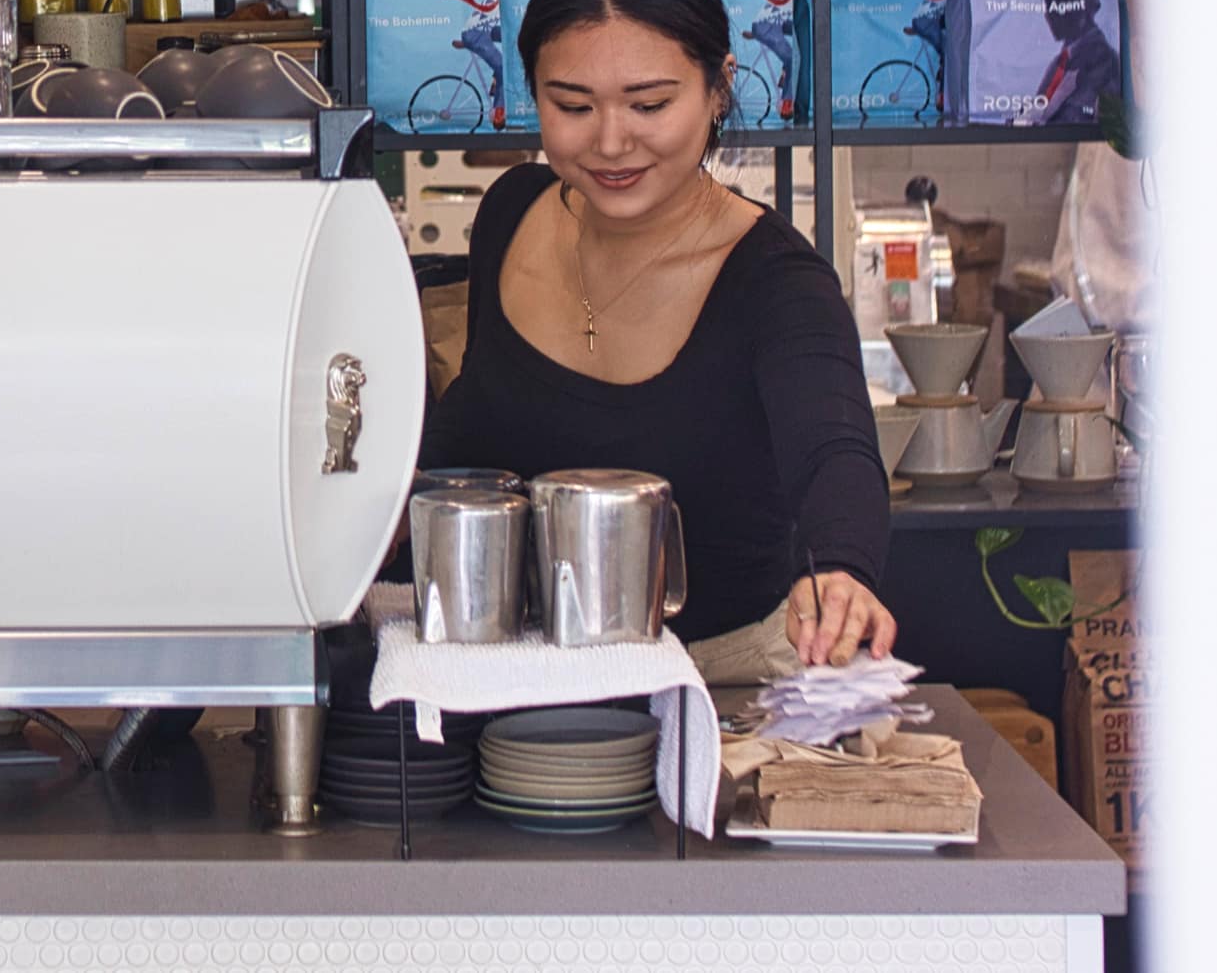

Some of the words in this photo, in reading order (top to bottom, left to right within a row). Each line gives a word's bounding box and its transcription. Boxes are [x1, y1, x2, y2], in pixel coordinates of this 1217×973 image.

[986, 0, 1008, 12] The
[392, 14, 450, 27] Bohemian
[832, 94, 885, 109] OSSO
[984, 94, 1049, 111] ROSSO
